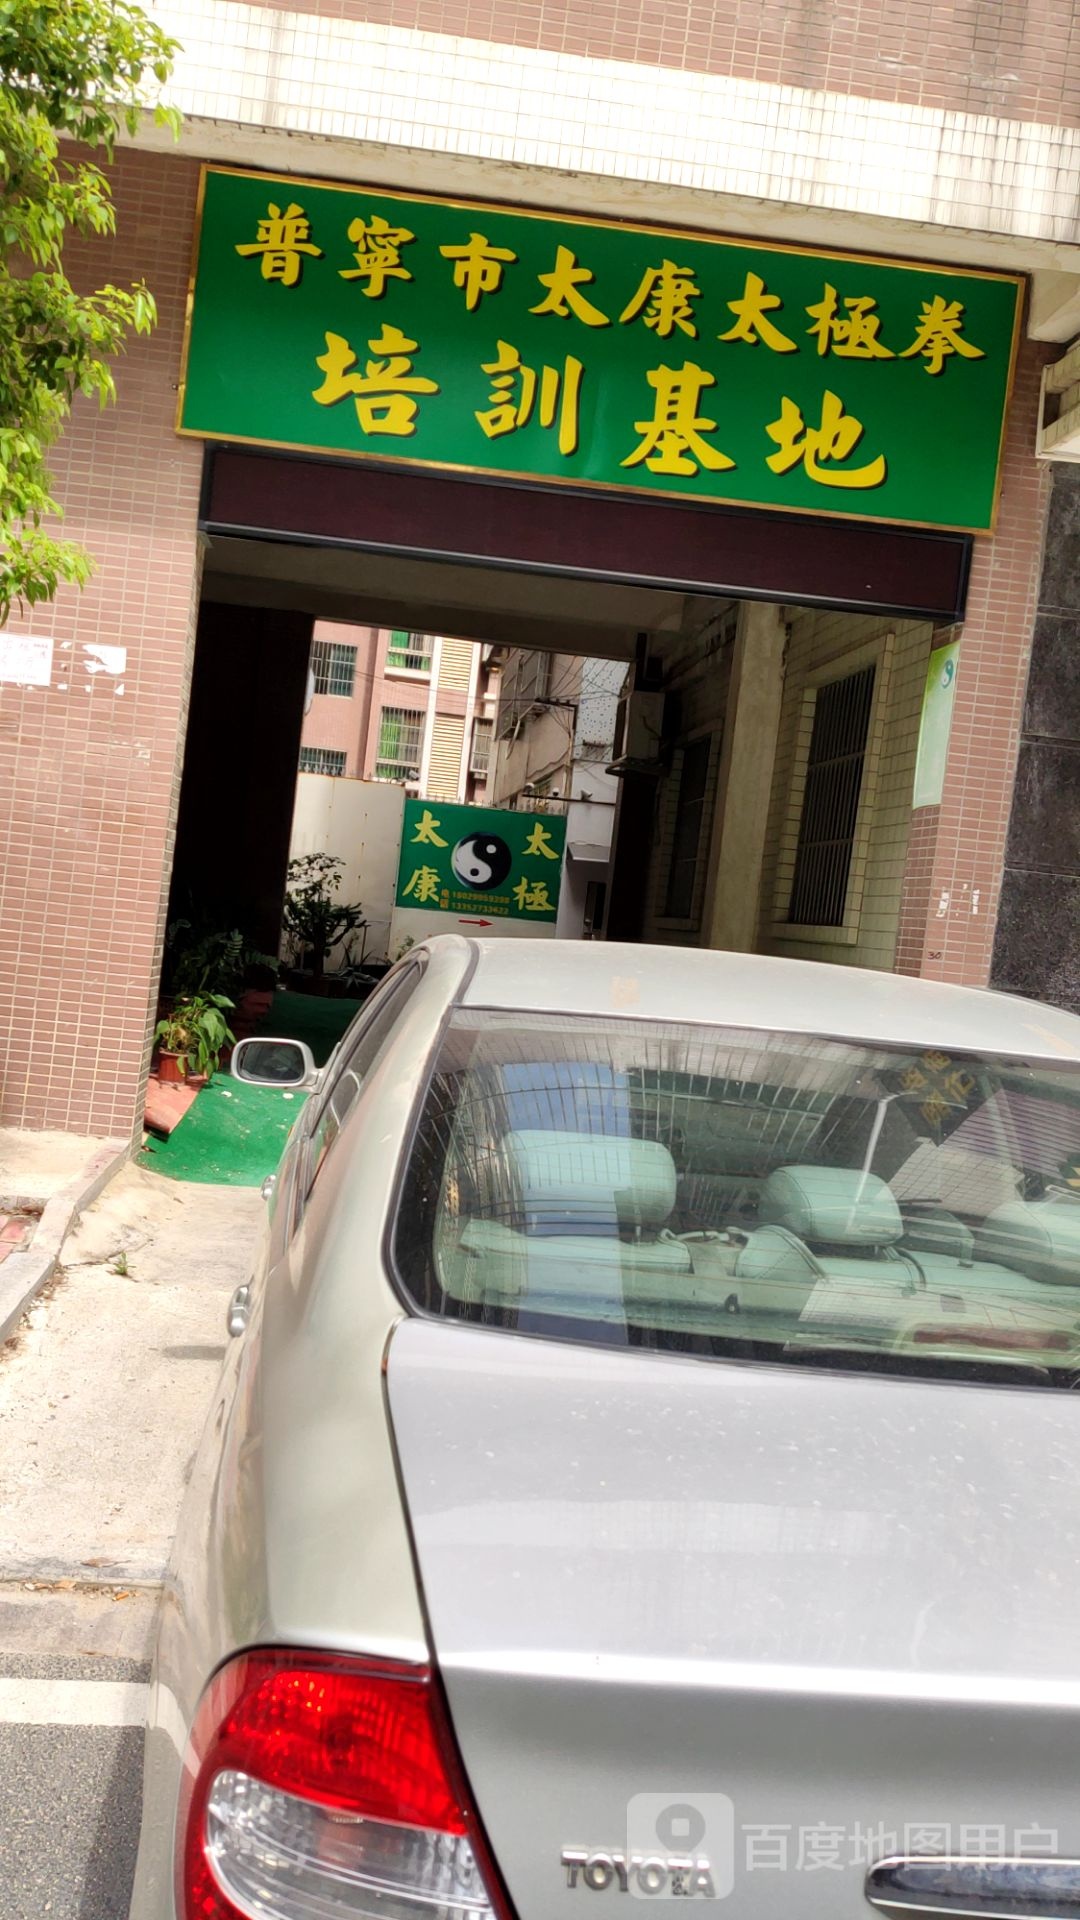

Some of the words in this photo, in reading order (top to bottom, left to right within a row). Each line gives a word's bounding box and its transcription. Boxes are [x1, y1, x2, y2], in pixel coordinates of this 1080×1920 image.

[234, 202, 986, 375] 普寧市太康太極拳
[312, 323, 886, 488] 培訓基地
[402, 809, 449, 902] 太康
[512, 822, 560, 912] 太極
[561, 1850, 716, 1898] TOYOTA
